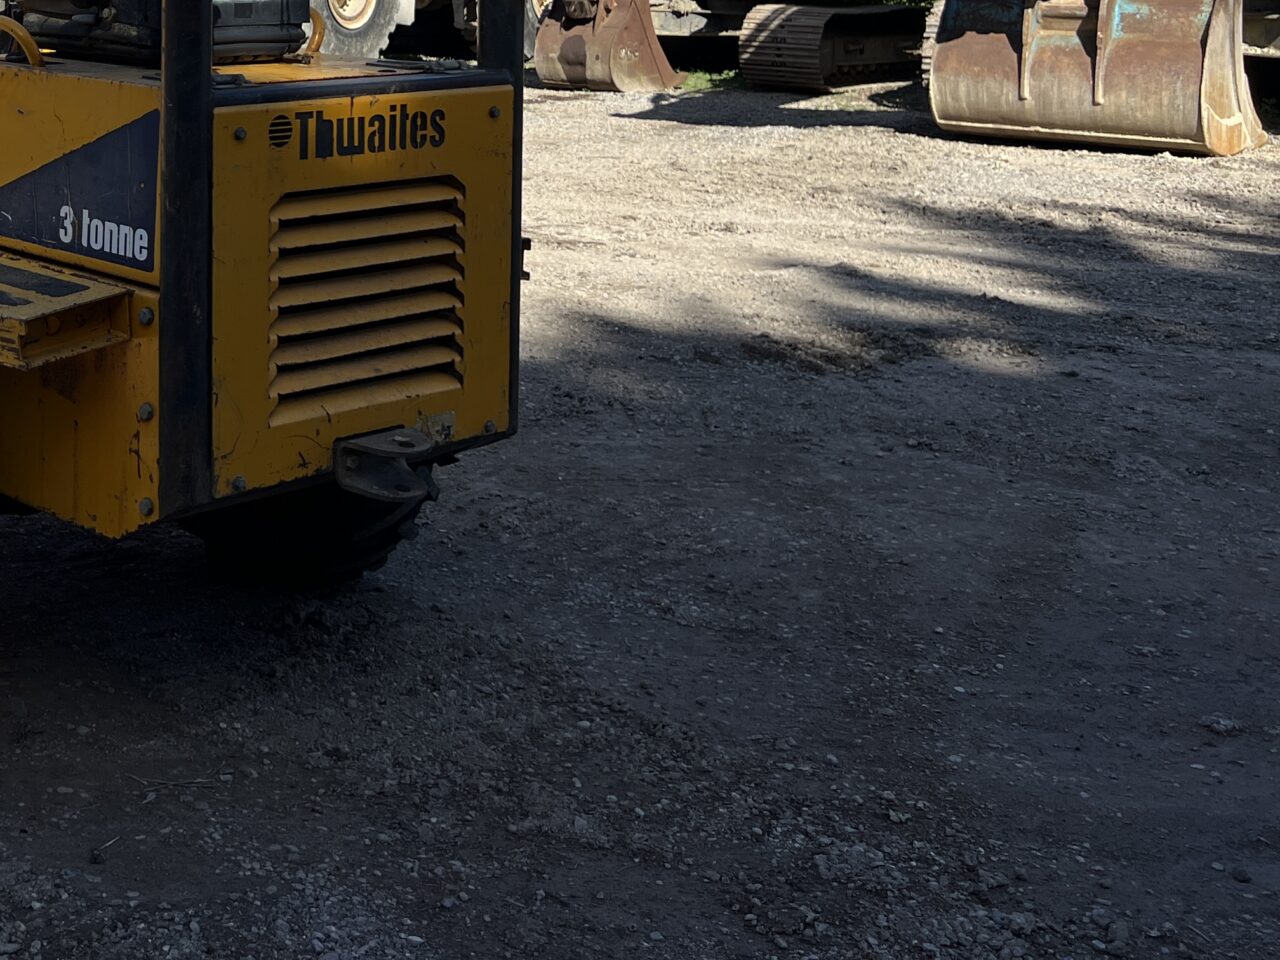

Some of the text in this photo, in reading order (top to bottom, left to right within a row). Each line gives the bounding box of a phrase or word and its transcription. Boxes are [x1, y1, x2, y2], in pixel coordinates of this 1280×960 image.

[295, 104, 446, 160] Thwaites
[59, 205, 149, 261] 3 tonne
